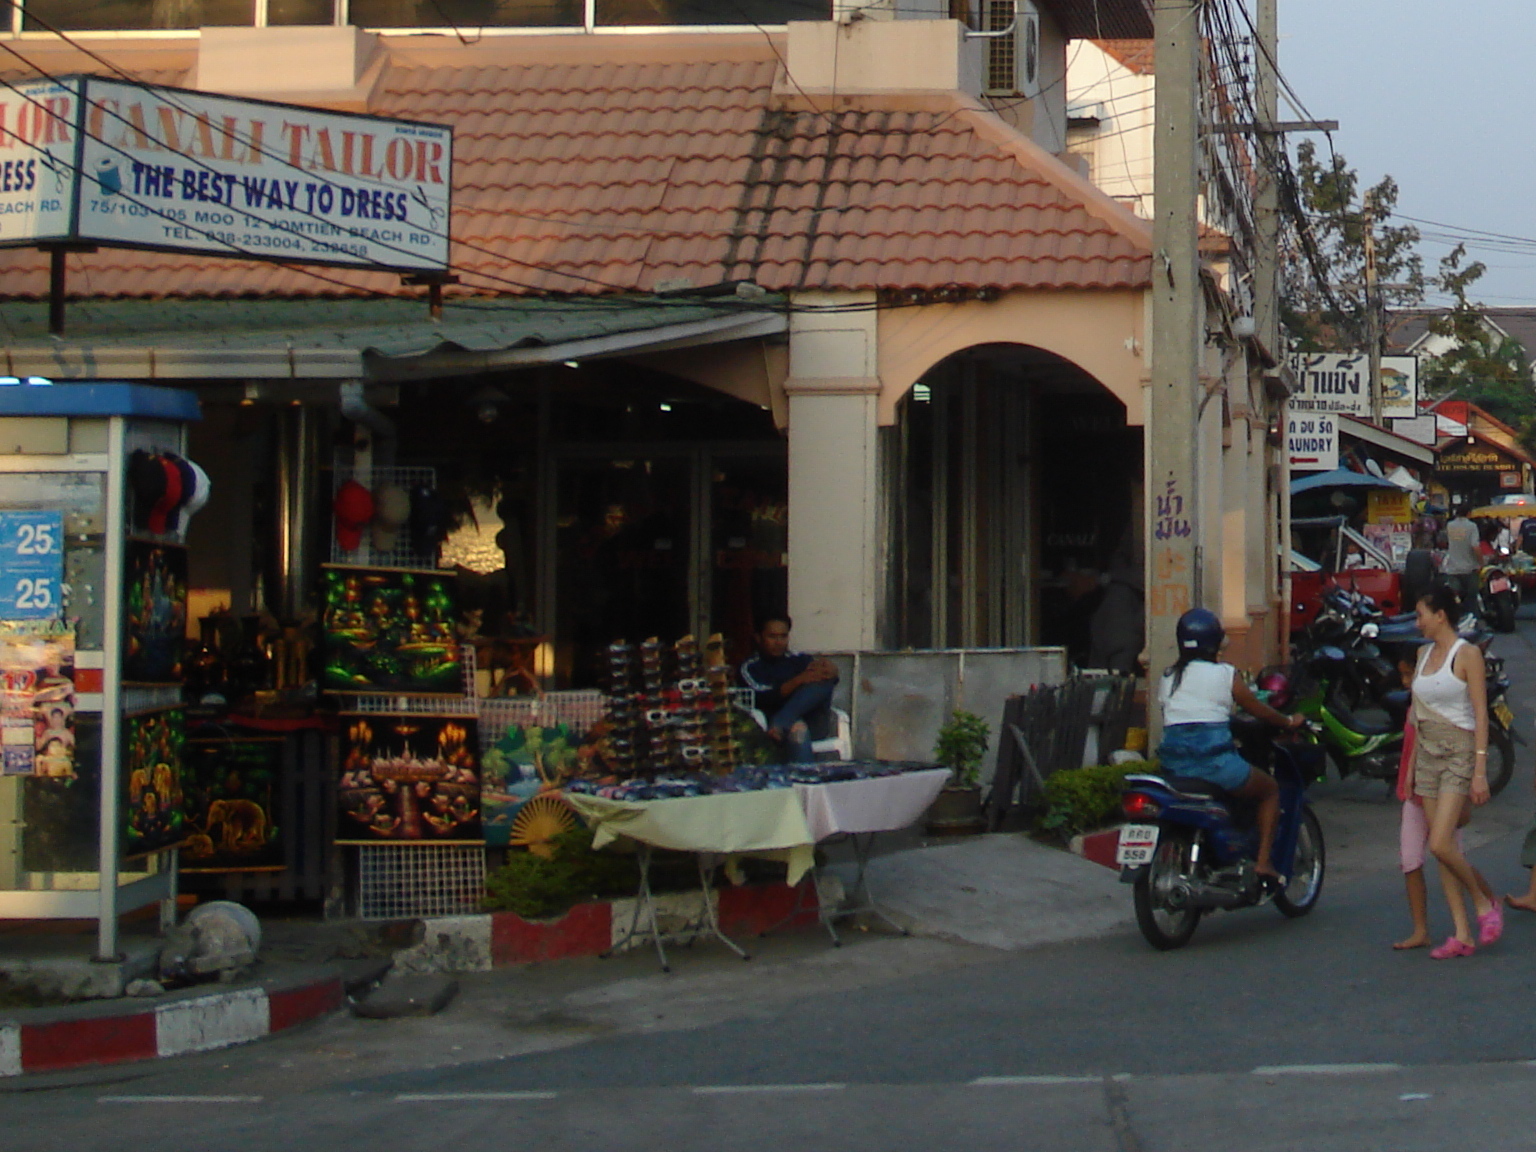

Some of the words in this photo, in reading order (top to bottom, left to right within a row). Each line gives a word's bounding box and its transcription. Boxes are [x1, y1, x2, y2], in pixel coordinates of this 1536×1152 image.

[90, 99, 265, 165] CANALI
[281, 120, 444, 184] TAILOR
[40, 200, 62, 211] RD.
[132, 162, 175, 199] THE
[182, 168, 237, 206] BEST
[243, 176, 298, 212] WAY
[305, 183, 334, 215] TO
[341, 187, 407, 222] DRESS
[90, 200, 187, 221] 75/103-105
[195, 213, 234, 226] MOO
[245, 218, 260, 229] 12
[269, 218, 341, 237] JOMTIEN
[350, 227, 402, 243] BEACH
[409, 233, 436, 246] RD.
[162, 226, 198, 241] TEL.
[17, 524, 54, 555] 25
[16, 578, 51, 609] 25
